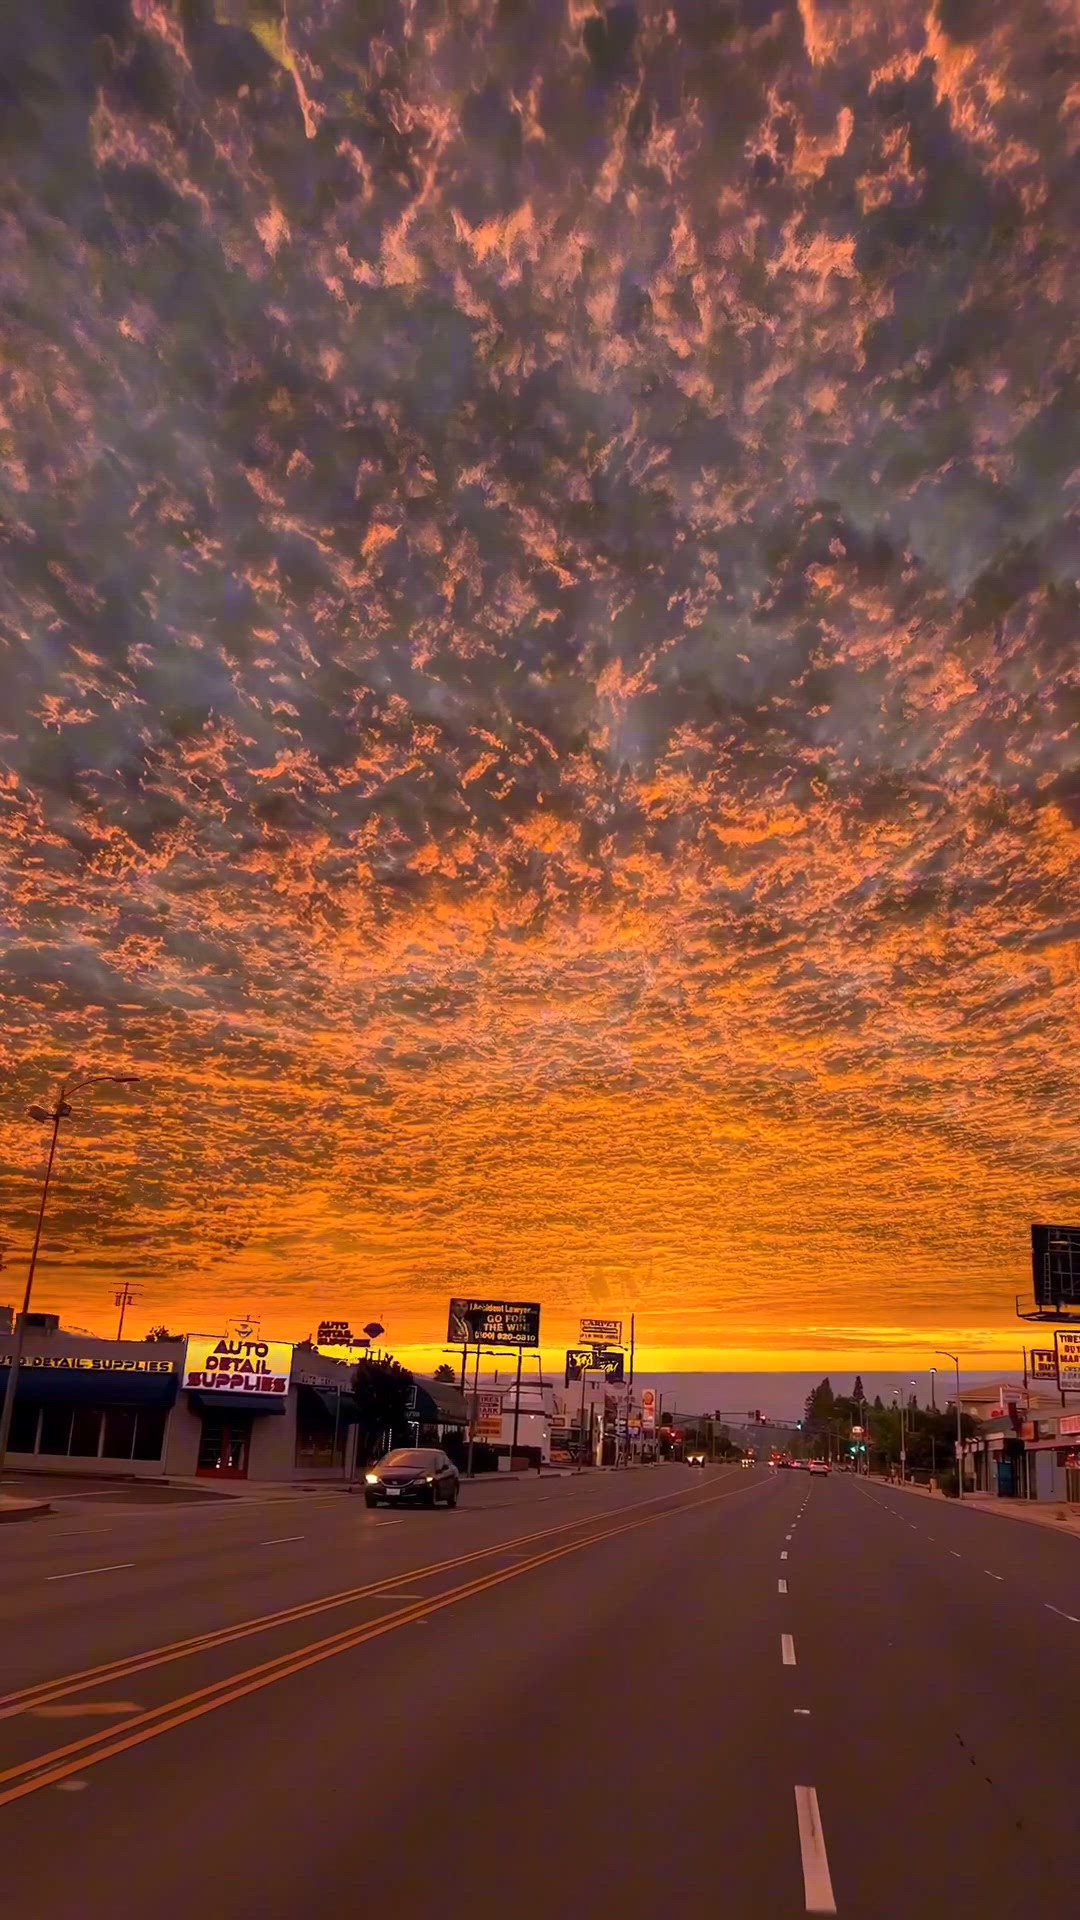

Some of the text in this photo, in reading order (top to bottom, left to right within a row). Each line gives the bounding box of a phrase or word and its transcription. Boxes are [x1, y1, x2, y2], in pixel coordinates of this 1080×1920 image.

[318, 1321, 348, 1329] AUTO
[487, 1315, 526, 1323] GO FOR
[483, 1323, 503, 1331] THE
[213, 1340, 268, 1357] AUTO
[33, 1357, 87, 1368] DETAIL
[91, 1359, 169, 1372] SUPPLIES
[205, 1356, 271, 1375] DETAIL
[186, 1372, 287, 1392] SUPPLIES
